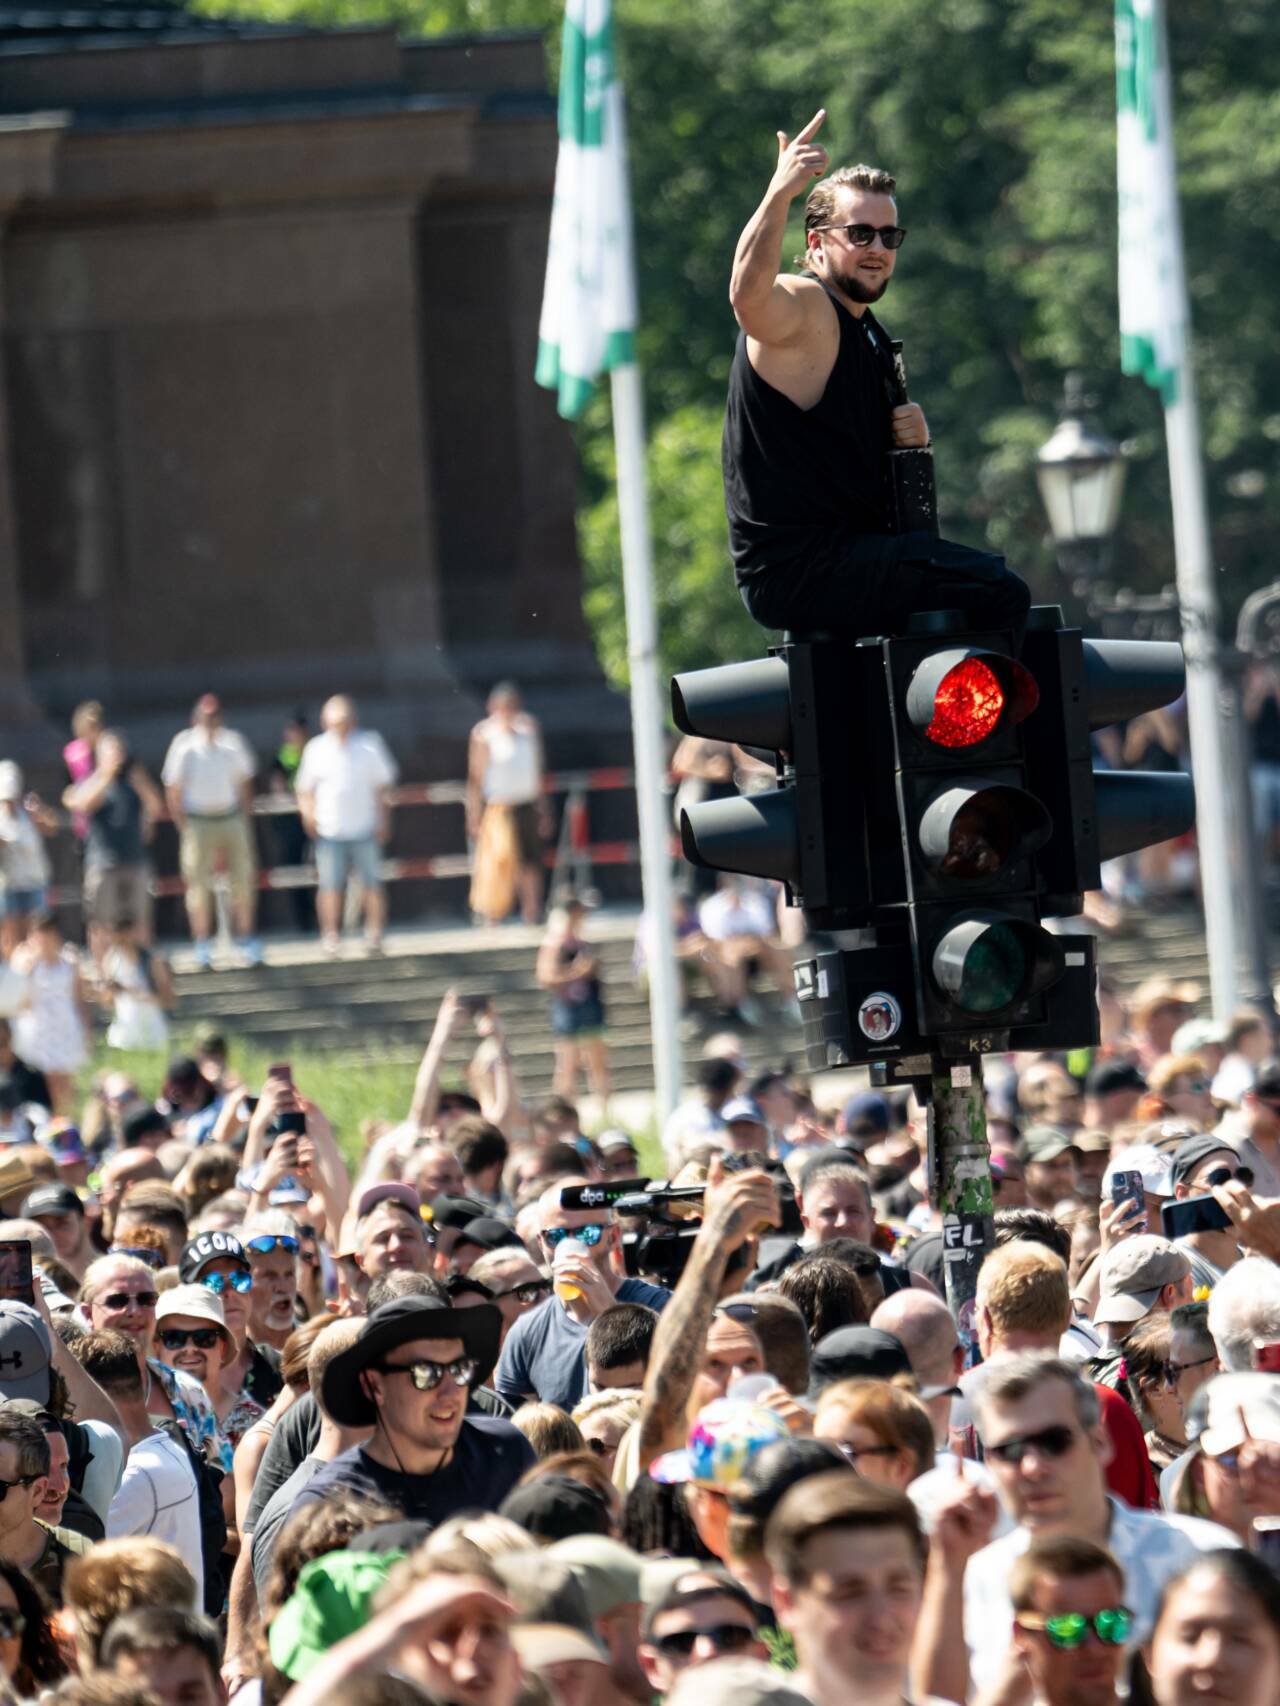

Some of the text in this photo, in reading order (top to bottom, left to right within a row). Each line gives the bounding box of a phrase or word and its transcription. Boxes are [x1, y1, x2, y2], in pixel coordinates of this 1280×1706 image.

[968, 1038, 992, 1053] K3
[580, 1187, 605, 1207] dpa
[188, 1231, 240, 1263] ICON
[945, 1224, 984, 1248] FL
